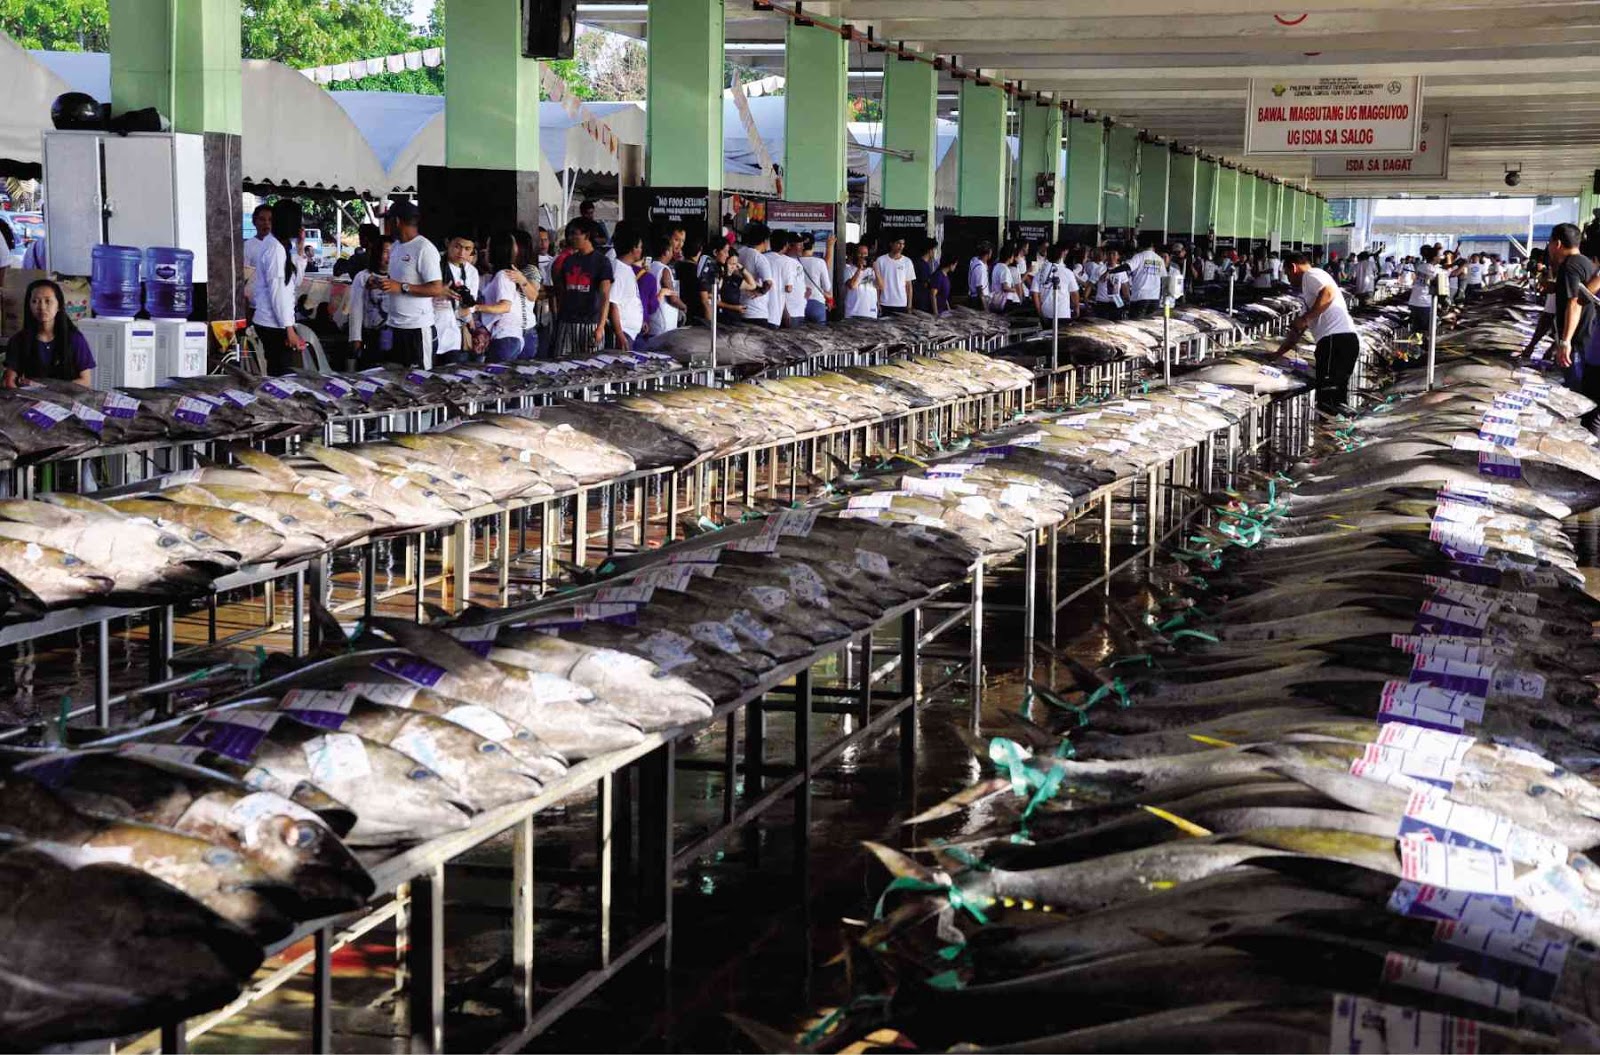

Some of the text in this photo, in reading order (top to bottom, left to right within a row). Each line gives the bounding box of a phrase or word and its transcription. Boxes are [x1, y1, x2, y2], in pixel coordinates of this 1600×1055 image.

[1258, 104, 1409, 122] BAWAL MAGBUTANG UG MAGGUYOD
[1287, 128, 1373, 145] UG ISDA SA SALOG
[1346, 159, 1413, 171] ISDA SA DAGAT
[669, 197, 683, 207] FOOD
